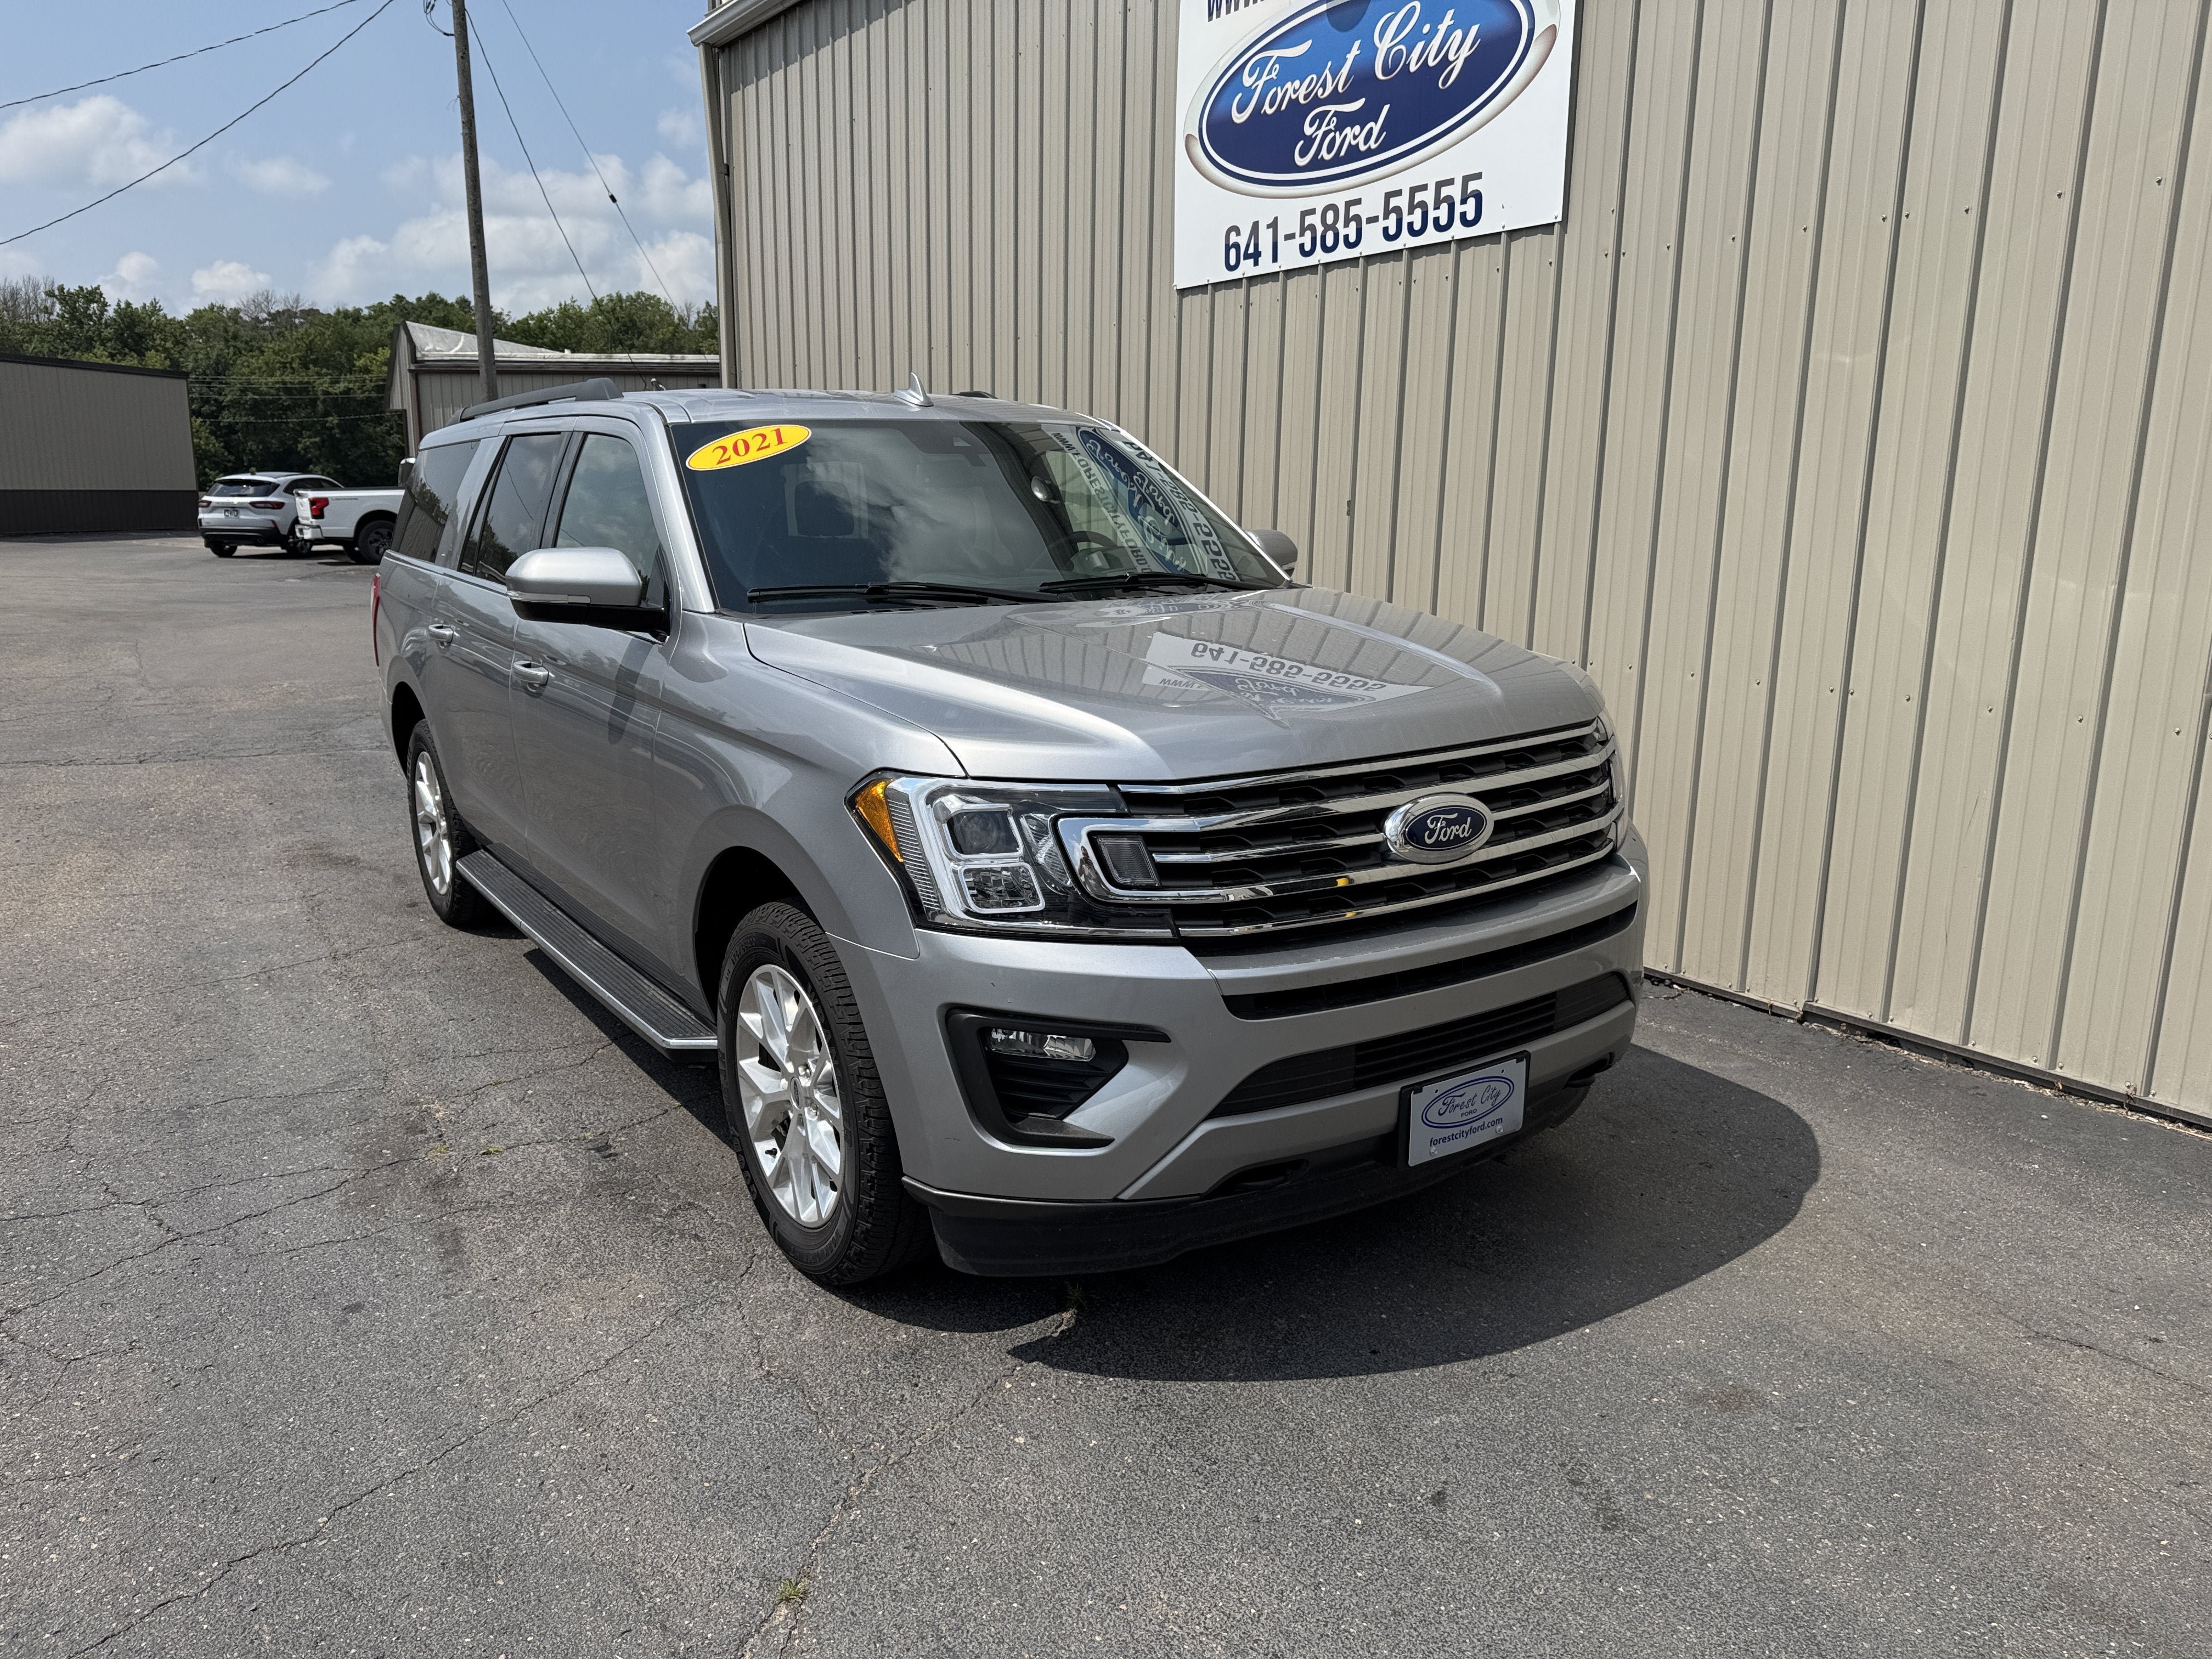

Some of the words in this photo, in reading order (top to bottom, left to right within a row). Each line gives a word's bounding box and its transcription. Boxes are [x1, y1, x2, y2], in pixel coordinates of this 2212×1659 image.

[1231, 39, 1361, 124] Forest
[1374, 0, 1481, 90] City
[1294, 98, 1390, 167] Ford
[1224, 171, 1483, 272] 641-585-5555
[712, 428, 787, 465] 2021
[1424, 812, 1472, 844] Ford
[1438, 1092, 1477, 1116] Forest
[1481, 1085, 1501, 1106] City
[1461, 1108, 1477, 1116] FORD
[1430, 1117, 1503, 1147] forestcityford.com
